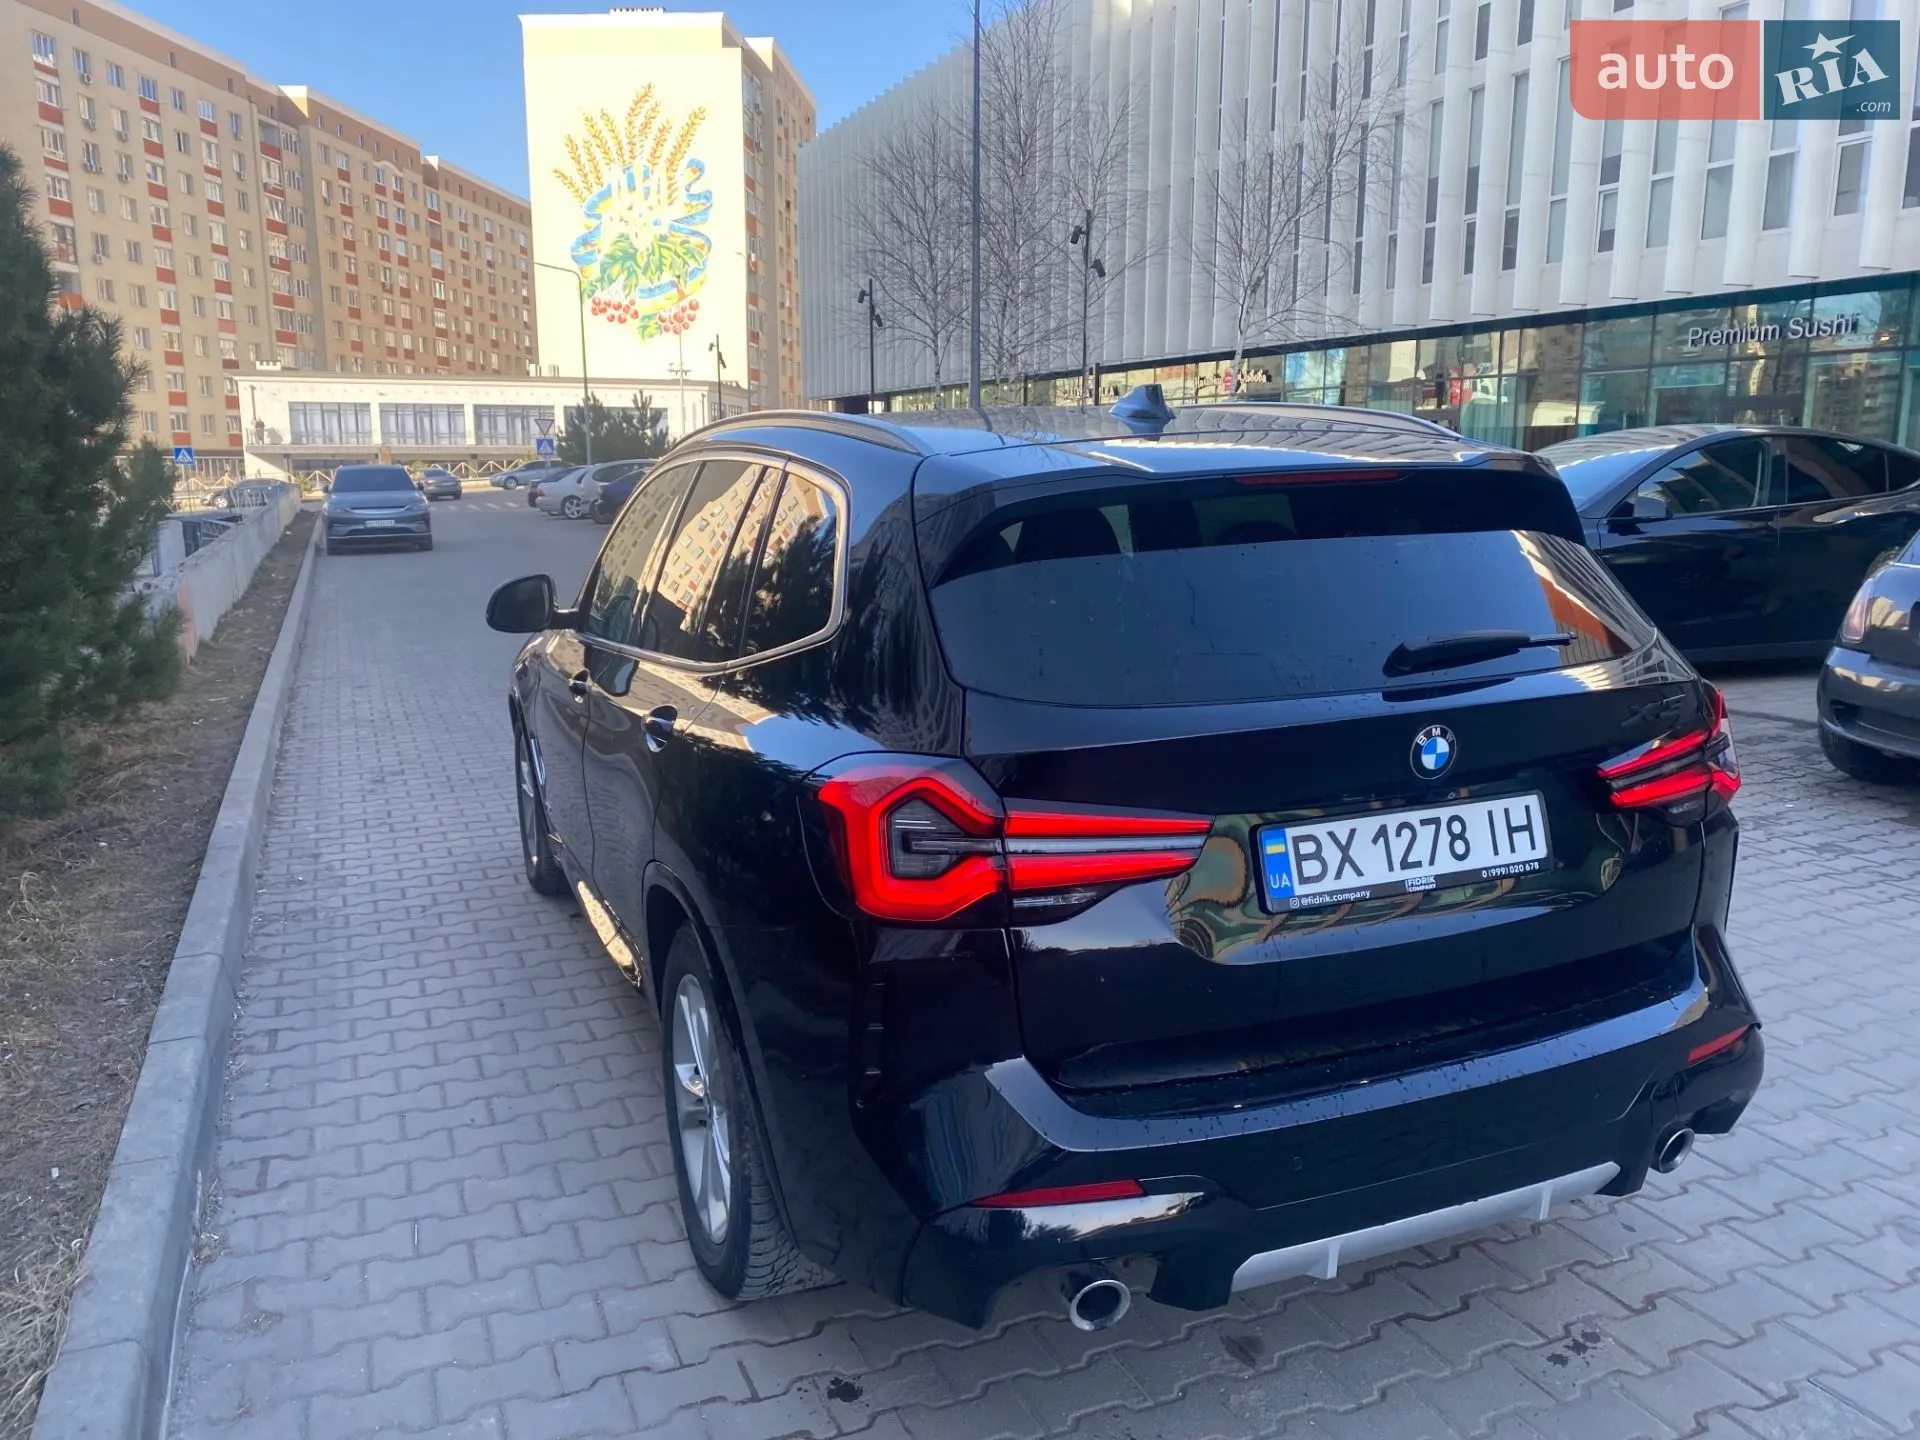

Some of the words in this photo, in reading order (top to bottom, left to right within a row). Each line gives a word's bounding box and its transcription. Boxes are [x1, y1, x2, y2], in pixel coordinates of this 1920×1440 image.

[1688, 324, 1780, 348] Premium
[1788, 314, 1855, 339] Sushi
[1417, 727, 1454, 746] BMW
[1292, 828, 1364, 885] BX
[1371, 815, 1470, 872] 1278
[1487, 805, 1536, 856] IH
[1488, 867, 1508, 878] (999)
[1509, 864, 1524, 874] 020
[1525, 862, 1539, 871] 678
[1270, 873, 1290, 889] UA
[1408, 876, 1436, 886] FIDRIK
[1409, 884, 1436, 892] COMPANY
[1301, 890, 1370, 906] @fidrik.company
